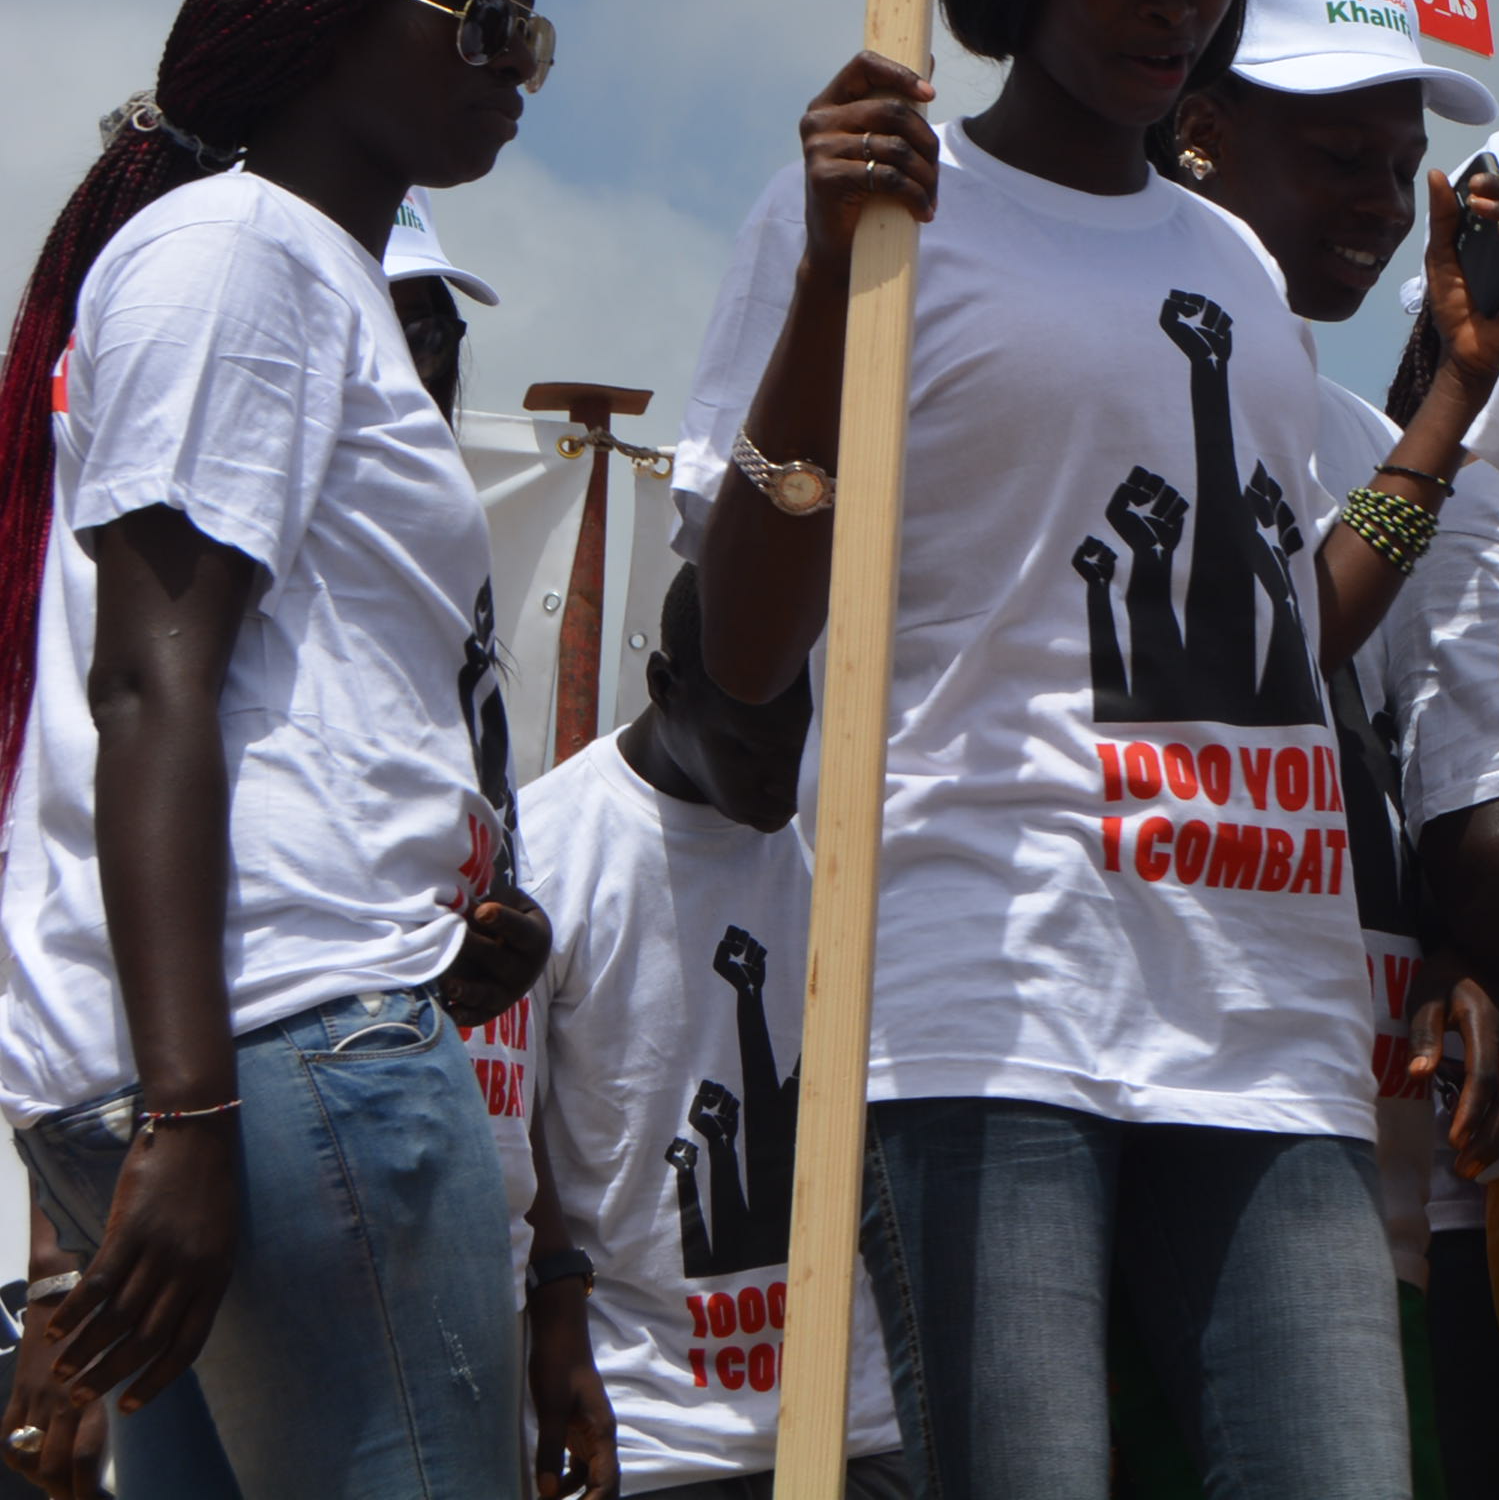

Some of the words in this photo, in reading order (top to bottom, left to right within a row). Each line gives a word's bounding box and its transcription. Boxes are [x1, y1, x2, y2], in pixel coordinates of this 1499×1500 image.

[1096, 741, 1231, 805] 1000
[1102, 816, 1122, 873] 1
[1134, 816, 1347, 896] COMBAT
